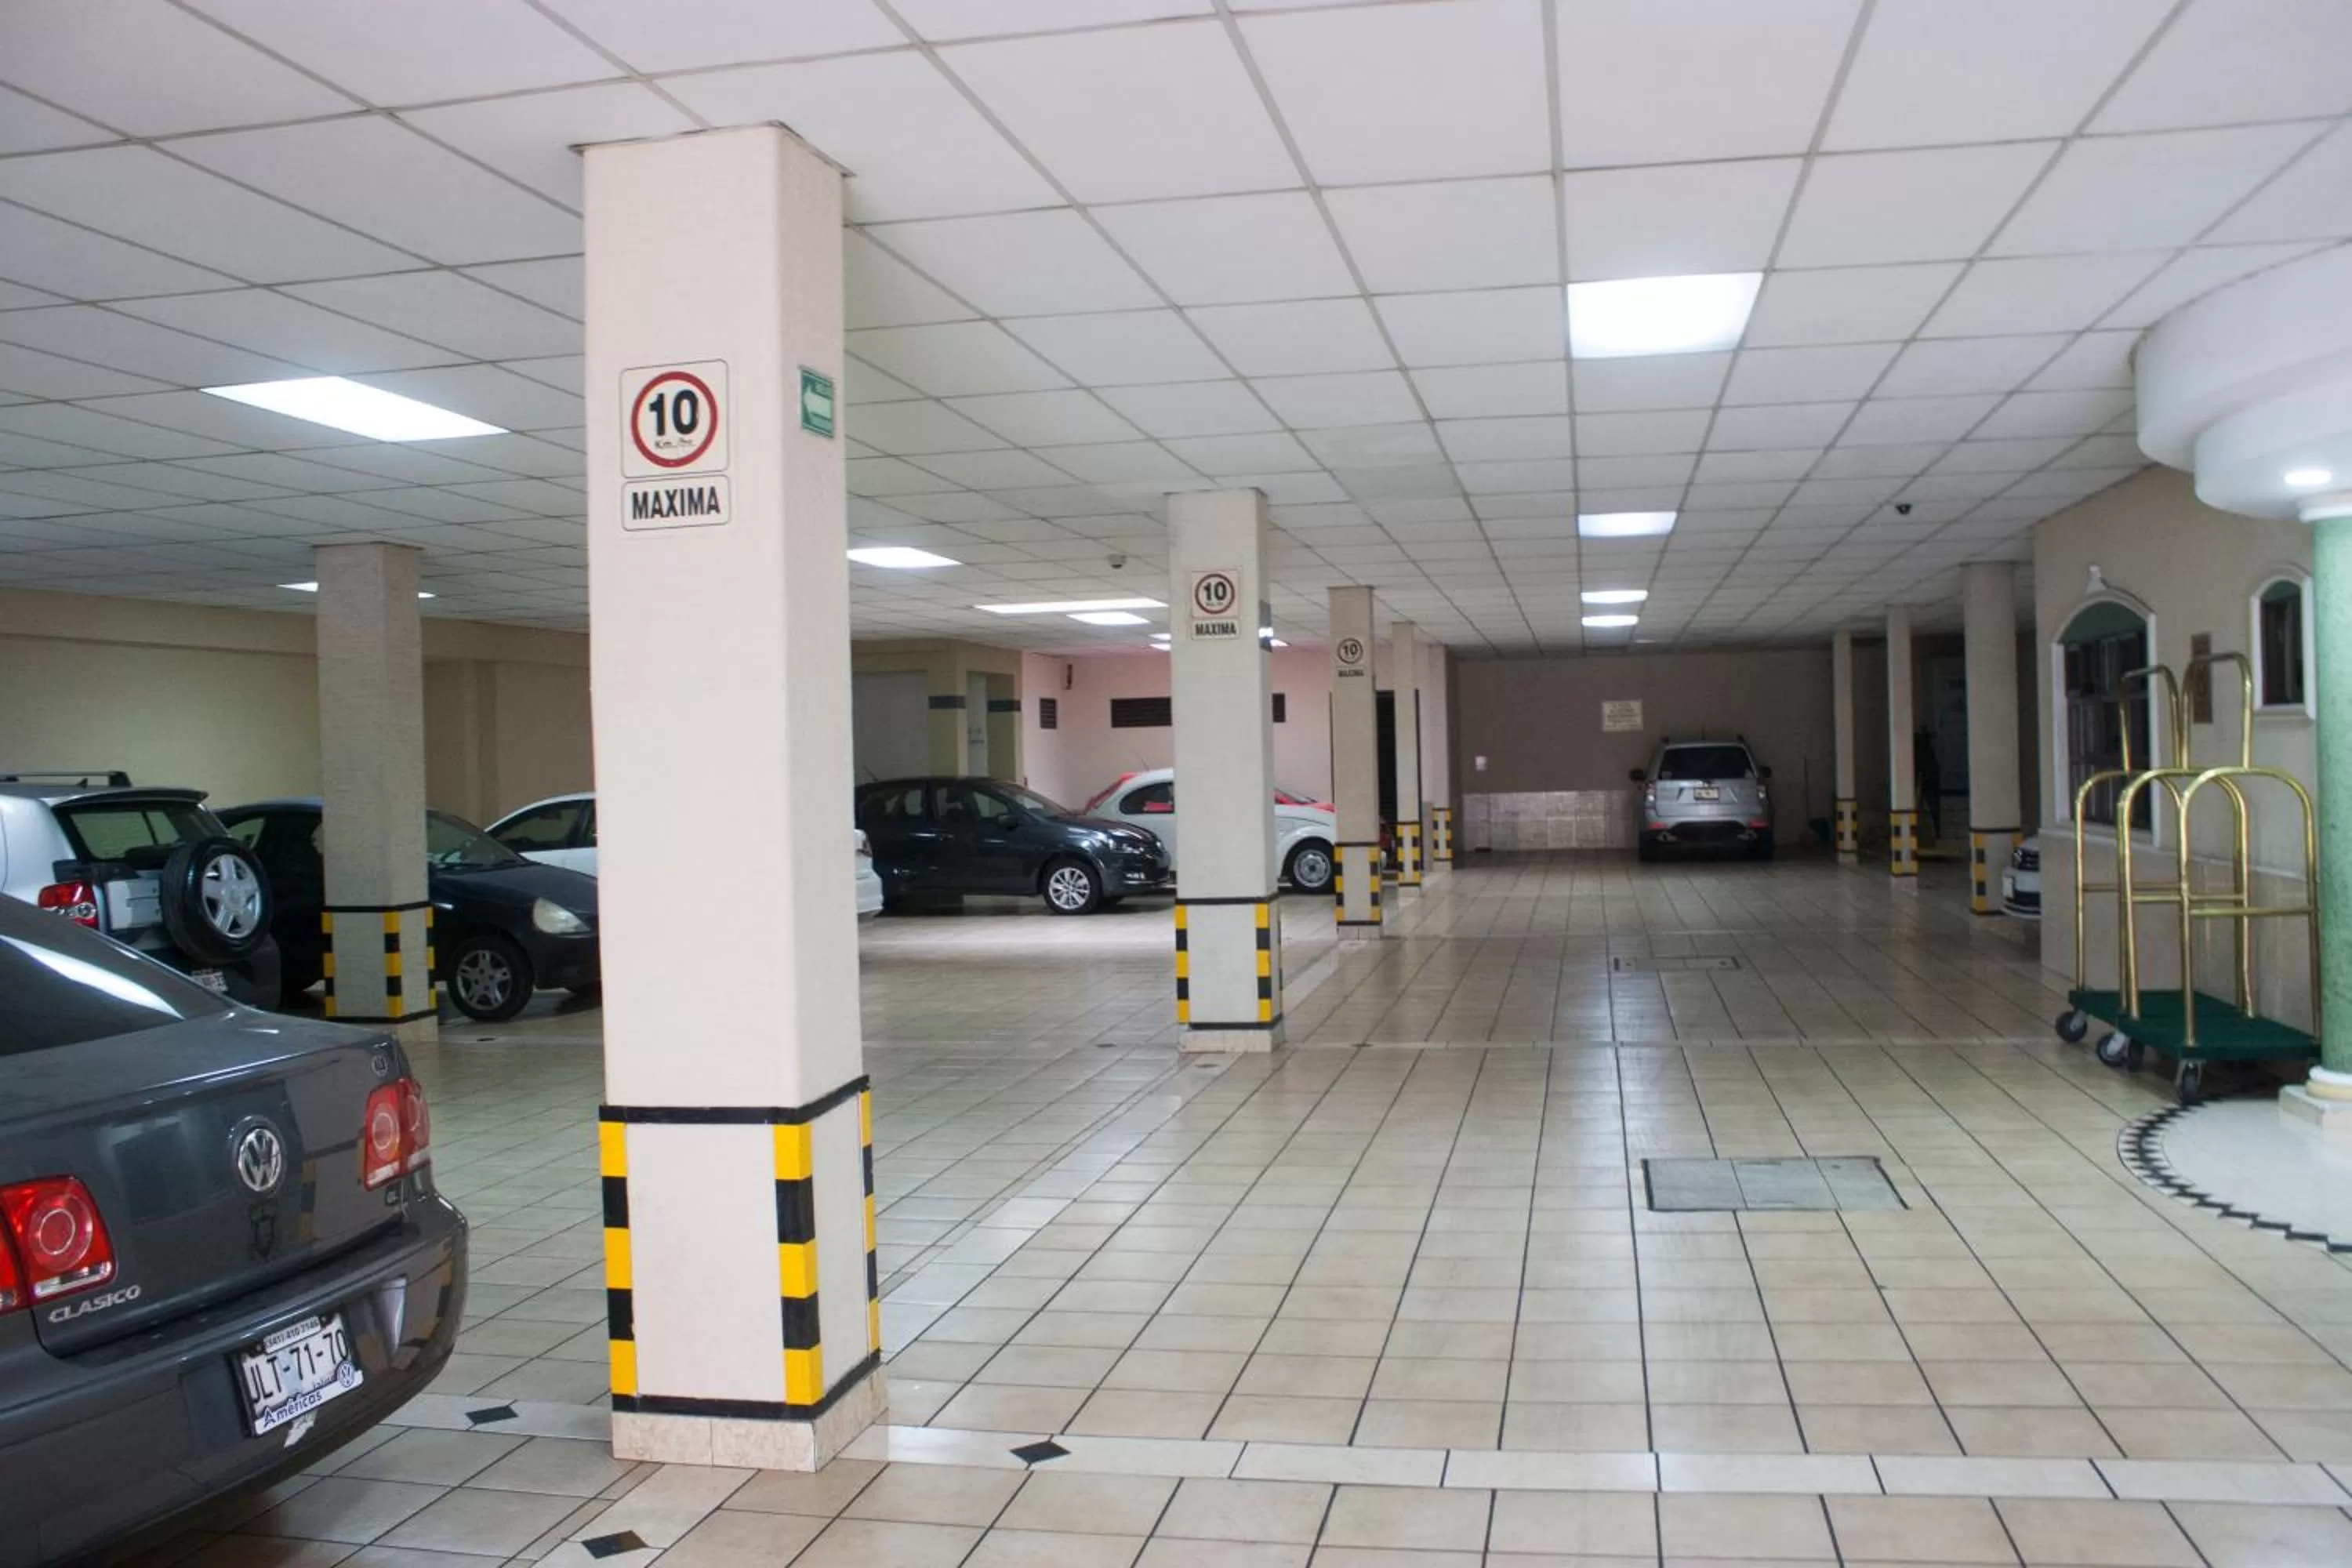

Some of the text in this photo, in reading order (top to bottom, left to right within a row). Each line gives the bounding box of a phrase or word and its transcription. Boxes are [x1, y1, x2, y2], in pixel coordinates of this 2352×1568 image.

[648, 389, 699, 437] 10
[632, 485, 720, 520] MAXIMA
[1203, 581, 1227, 601] 10
[1195, 622, 1236, 636] MAXIMA
[1342, 643, 1359, 656] 10
[49, 1285, 141, 1323] CLASICO
